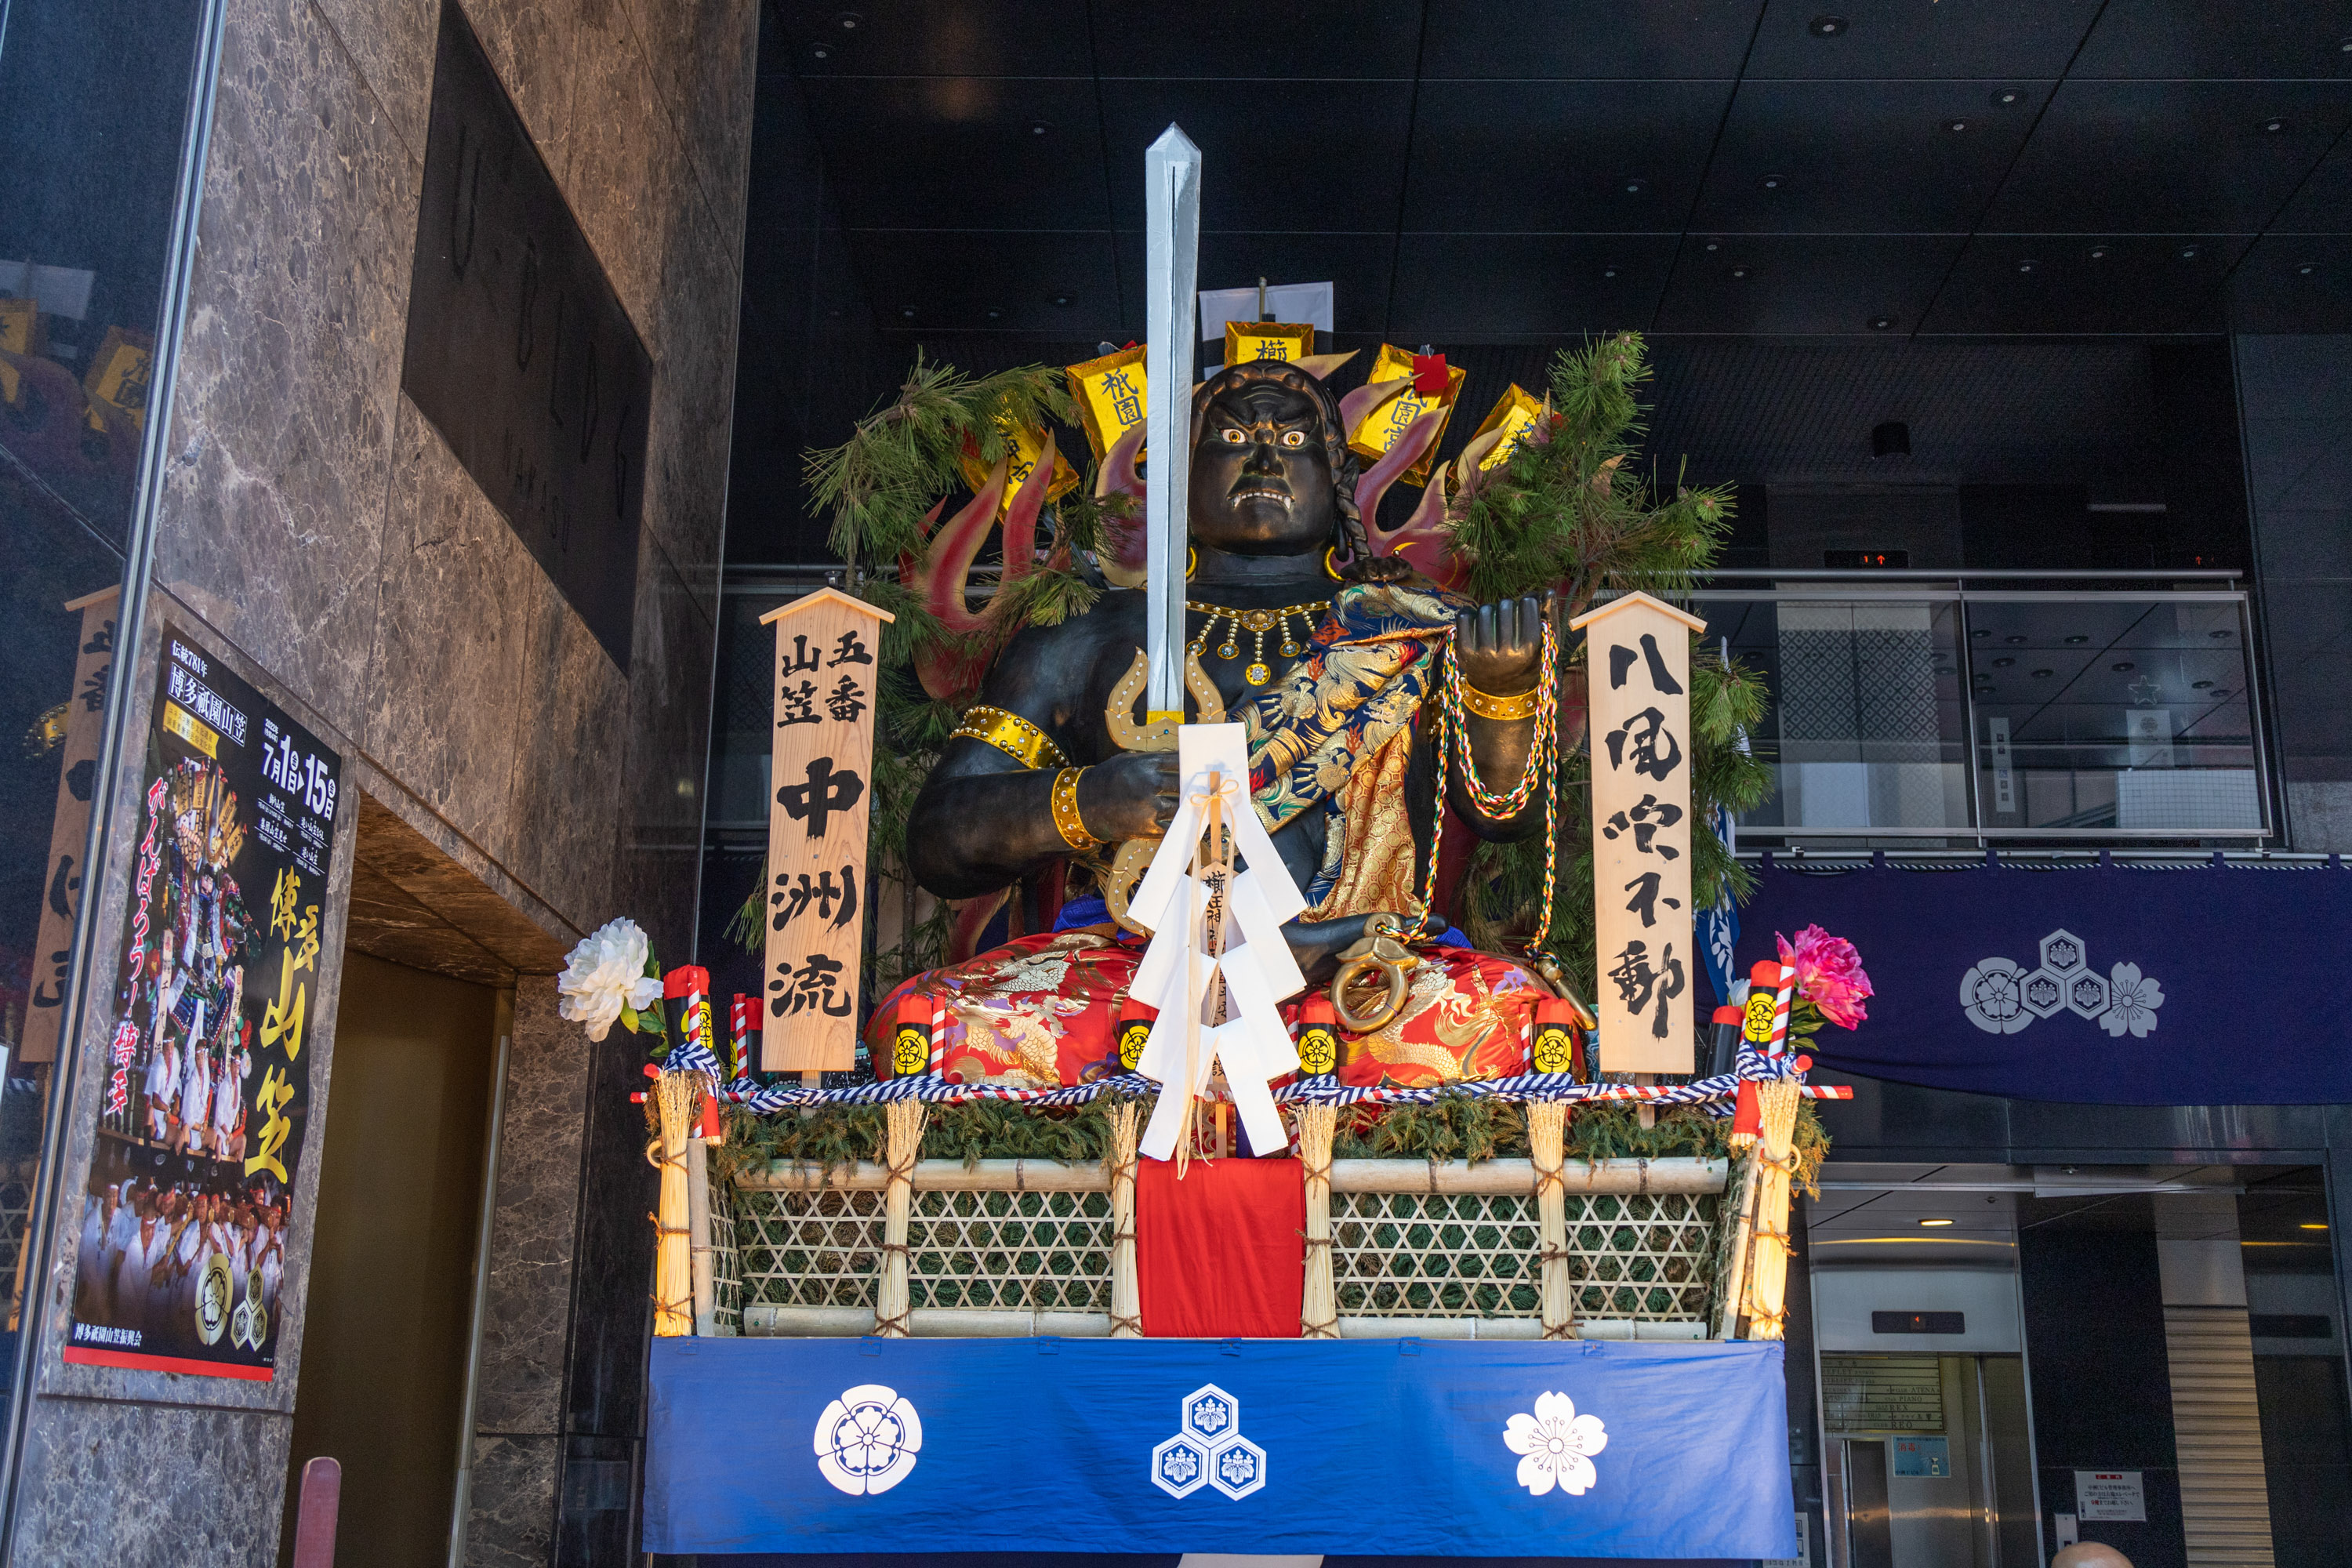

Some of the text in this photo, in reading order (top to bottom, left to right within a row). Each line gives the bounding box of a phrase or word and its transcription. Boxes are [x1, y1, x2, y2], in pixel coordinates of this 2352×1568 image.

[1101, 368, 1143, 437] 祇園
[172, 640, 208, 677] 伝統781年
[776, 634, 822, 729] 山笠
[824, 630, 873, 723] 五番
[170, 666, 246, 744] 博多祇園山笠
[768, 757, 865, 1018] 中洲流
